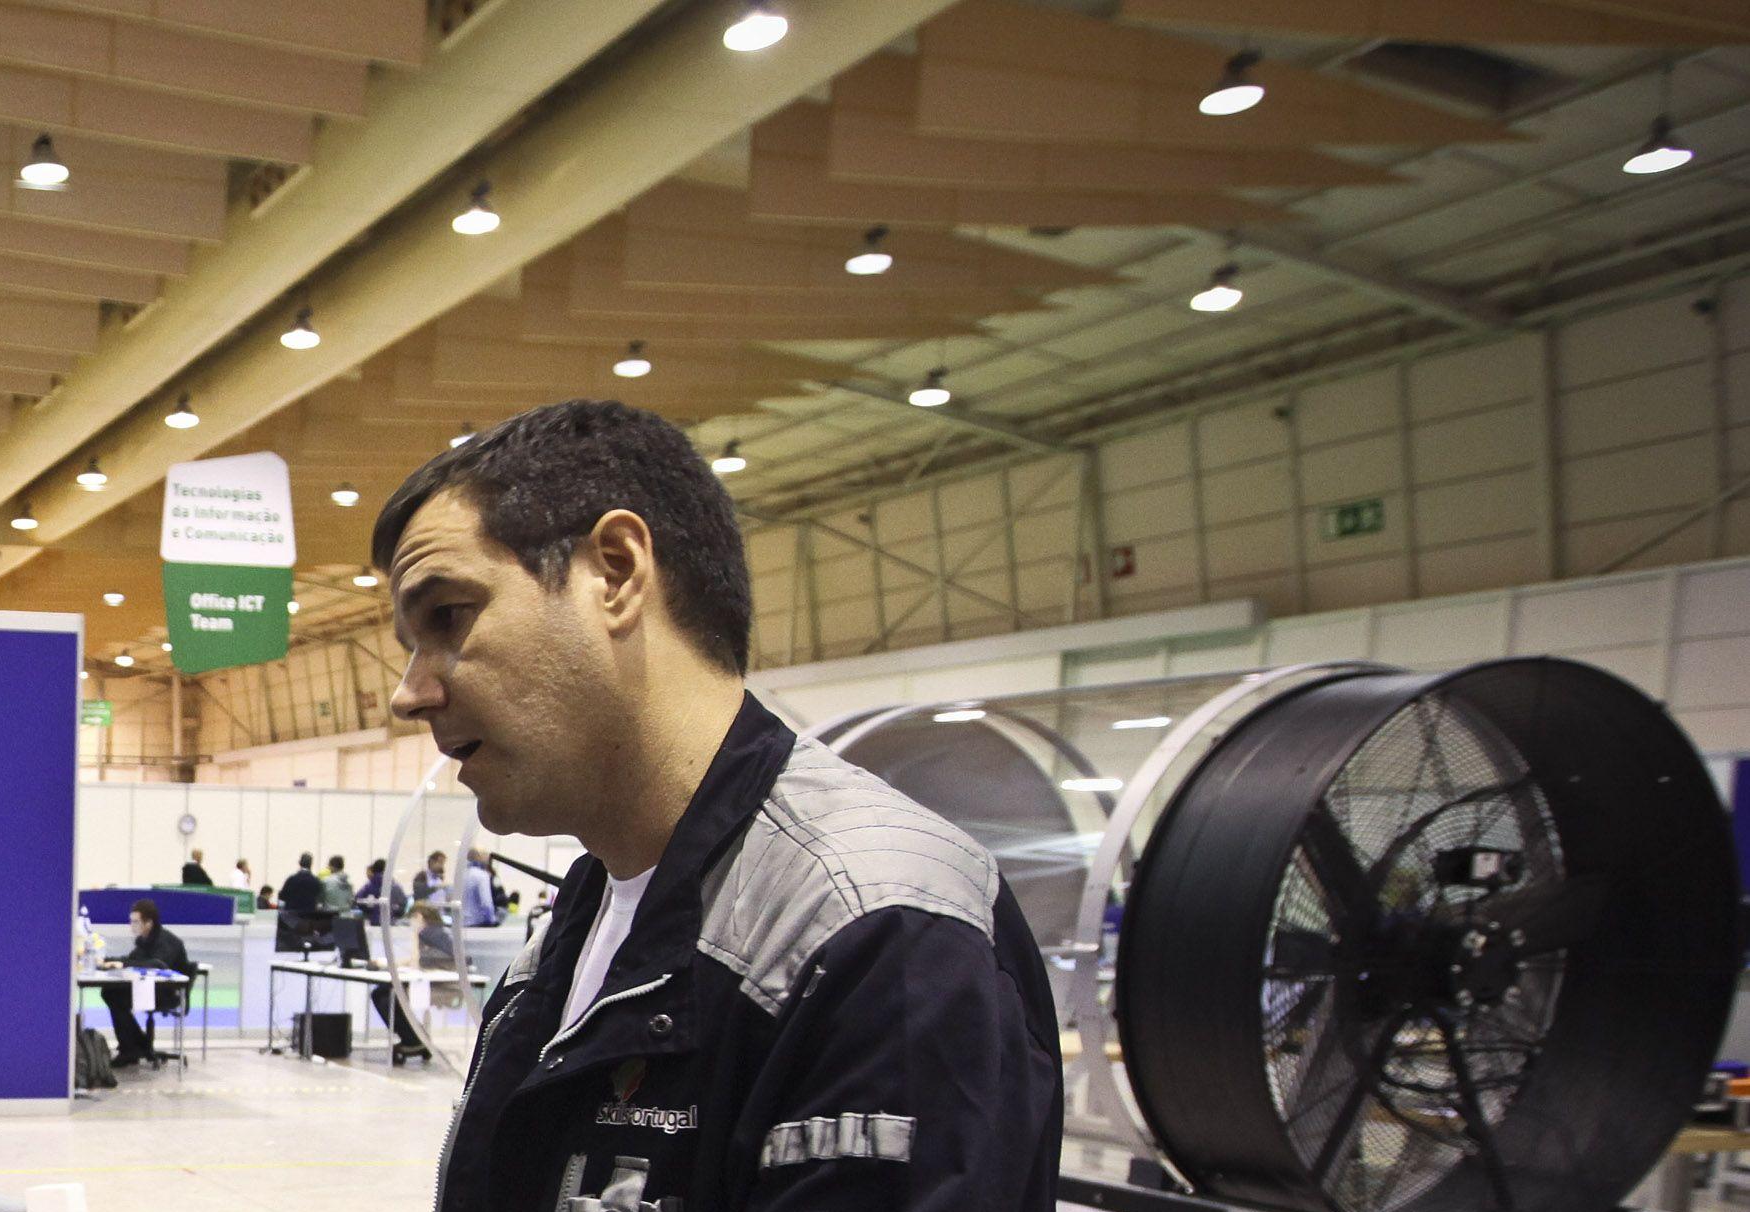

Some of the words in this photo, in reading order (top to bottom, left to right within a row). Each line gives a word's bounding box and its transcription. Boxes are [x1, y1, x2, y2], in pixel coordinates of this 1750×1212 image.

[172, 482, 262, 502] Tecnologias
[172, 505, 189, 518] da
[194, 505, 281, 525] Informação
[172, 529, 180, 538] e
[185, 527, 284, 545] Comunicação
[190, 593, 237, 611] Office
[238, 594, 265, 612] ICT
[190, 613, 234, 631] Team
